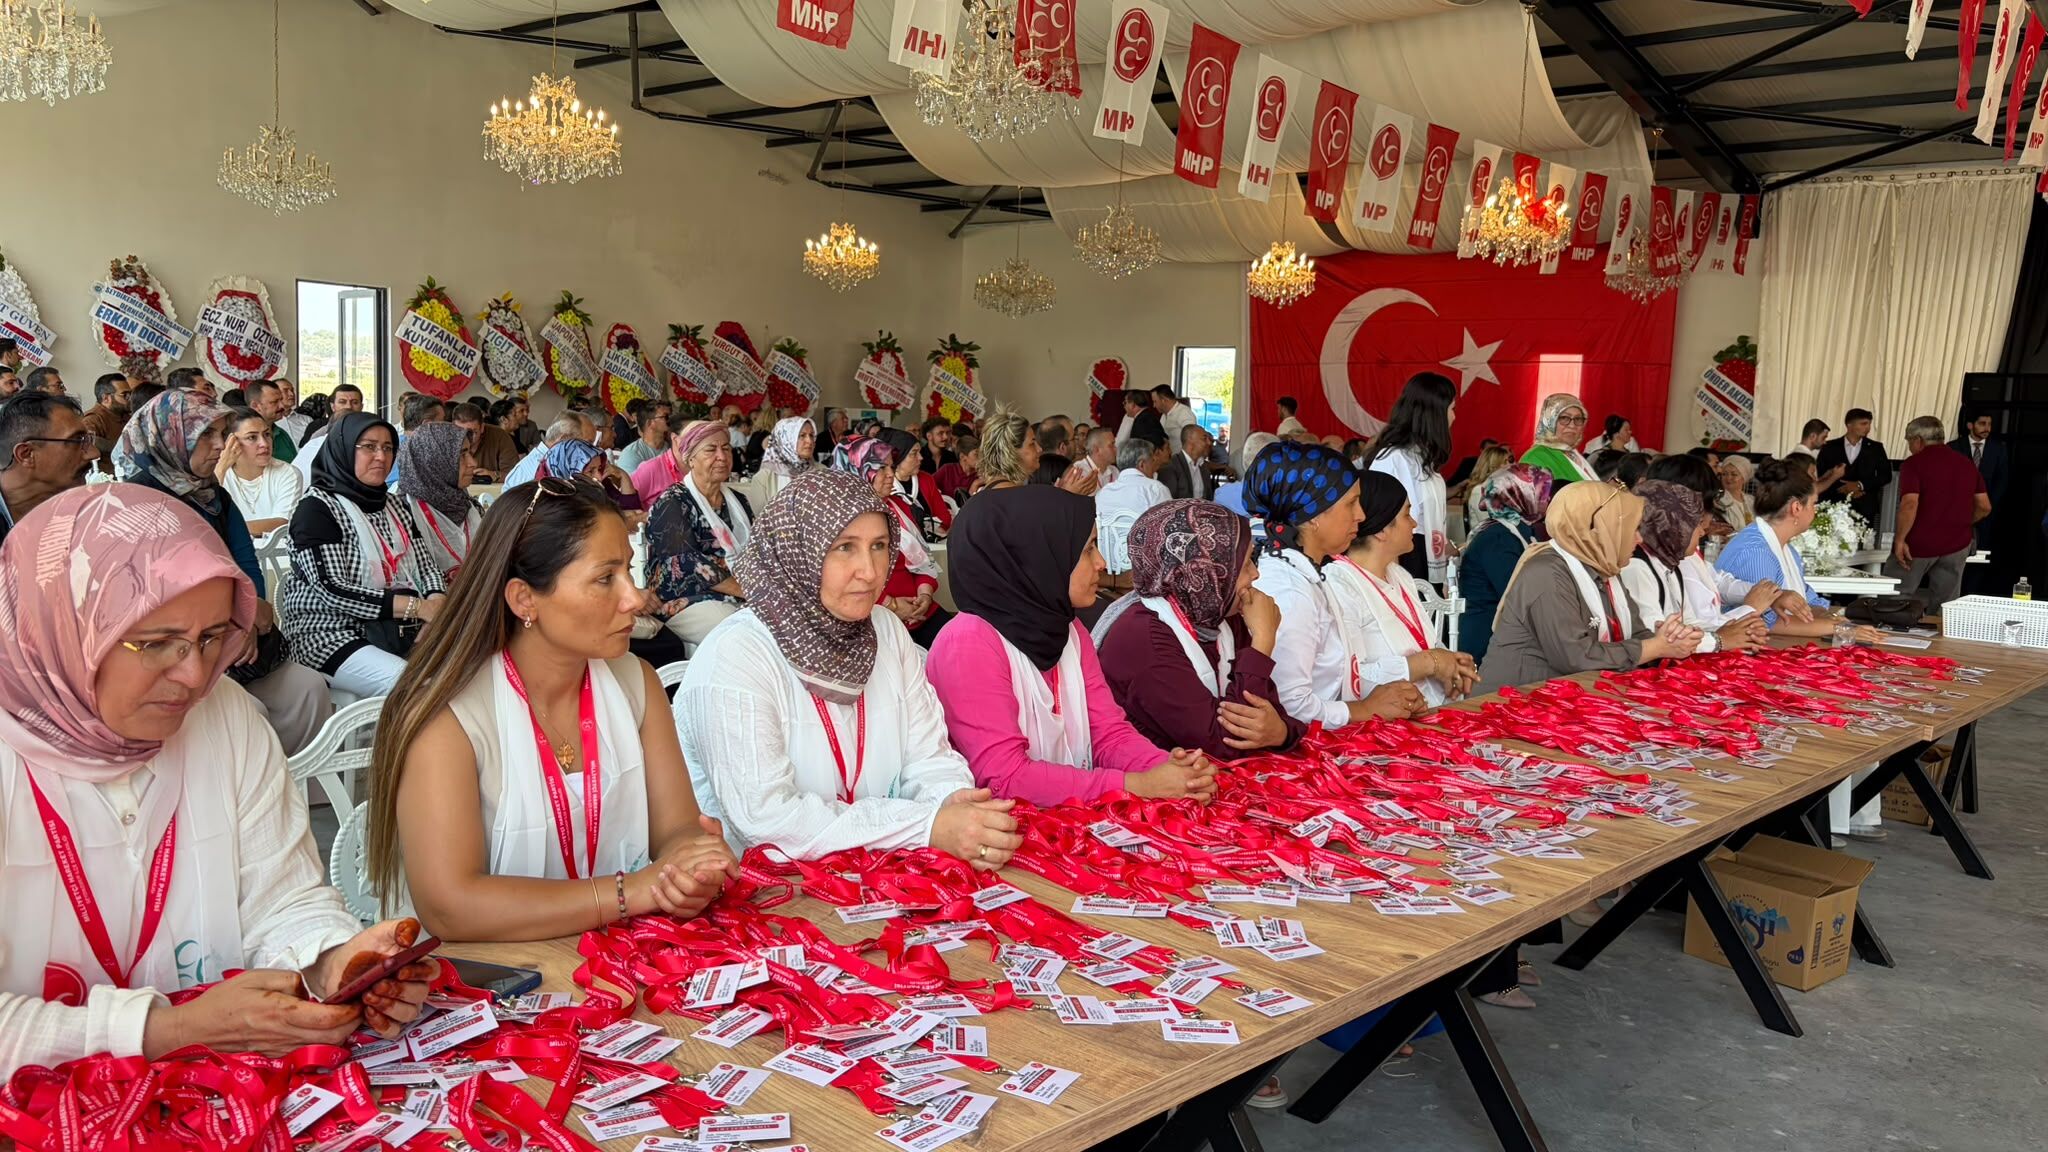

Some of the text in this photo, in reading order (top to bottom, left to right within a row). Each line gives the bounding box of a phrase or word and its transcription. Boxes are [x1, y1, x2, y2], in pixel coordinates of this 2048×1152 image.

[791, 0, 839, 34] MHP
[903, 25, 947, 60] MH
[1180, 148, 1215, 176] MHP
[1411, 219, 1436, 239] MH
[1656, 253, 1678, 269] MH
[6, 307, 52, 342] GÜVEN
[94, 303, 181, 356] ERKAN DOĞAN
[200, 305, 224, 326] ECZ.
[550, 317, 575, 344] JAPON
[10, 334, 43, 356] MUHTARI
[197, 322, 213, 337] MHP
[212, 326, 243, 348] BELEDİYE
[242, 337, 266, 356] MECLİS
[400, 327, 474, 375] KUYUMCULUK
[408, 313, 479, 362] TUFANLAR
[509, 348, 545, 381] BETON
[605, 347, 632, 370] LİKYA
[660, 354, 689, 378] ERDEM
[708, 332, 742, 362] TURGUT
[737, 353, 769, 381] TOKMAK
[770, 361, 801, 388] EMRE
[855, 370, 881, 389] MUTLU
[1701, 365, 1732, 392] ÖNDER
[1694, 388, 1735, 423] SEYDİKEMER
[547, 775, 558, 799] PARTİSİ
[552, 798, 564, 826] HAREKET
[45, 819, 91, 923] MİLLİYETÇİ HAREKET PARTİSİ
[158, 847, 171, 881] HAREKET
[152, 882, 165, 912] PARTİSİ
[344, 1074, 367, 1107] PARTİSİ
